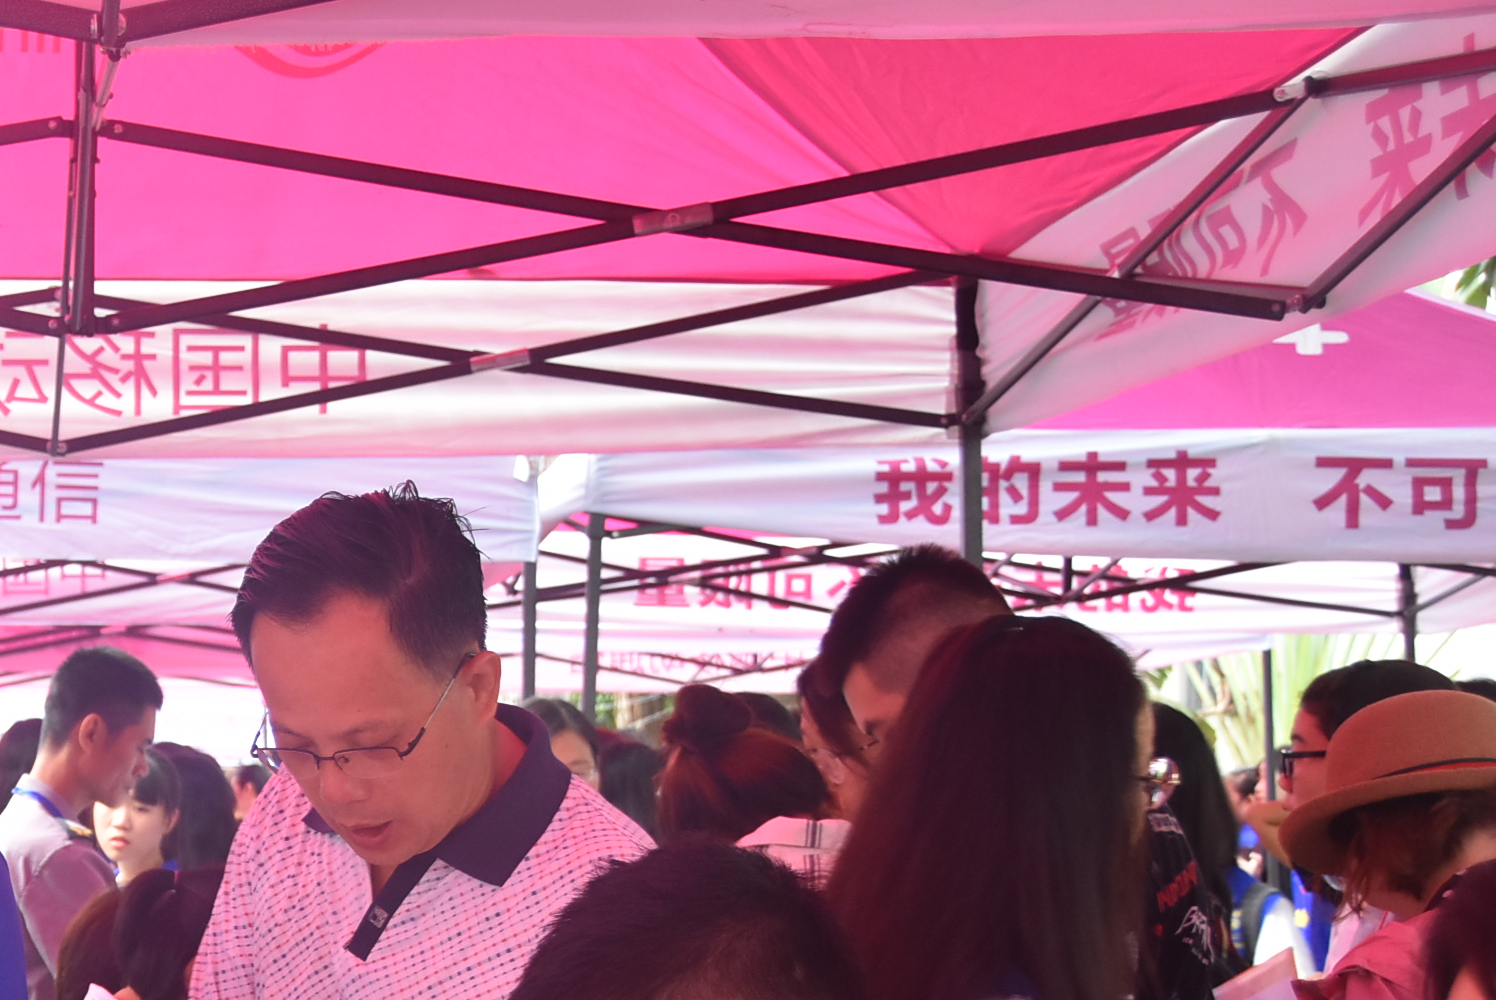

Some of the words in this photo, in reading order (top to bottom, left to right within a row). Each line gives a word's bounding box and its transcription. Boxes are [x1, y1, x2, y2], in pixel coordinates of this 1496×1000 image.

[874, 452, 1221, 527] 我的未来
[1313, 456, 1485, 530] 不可
